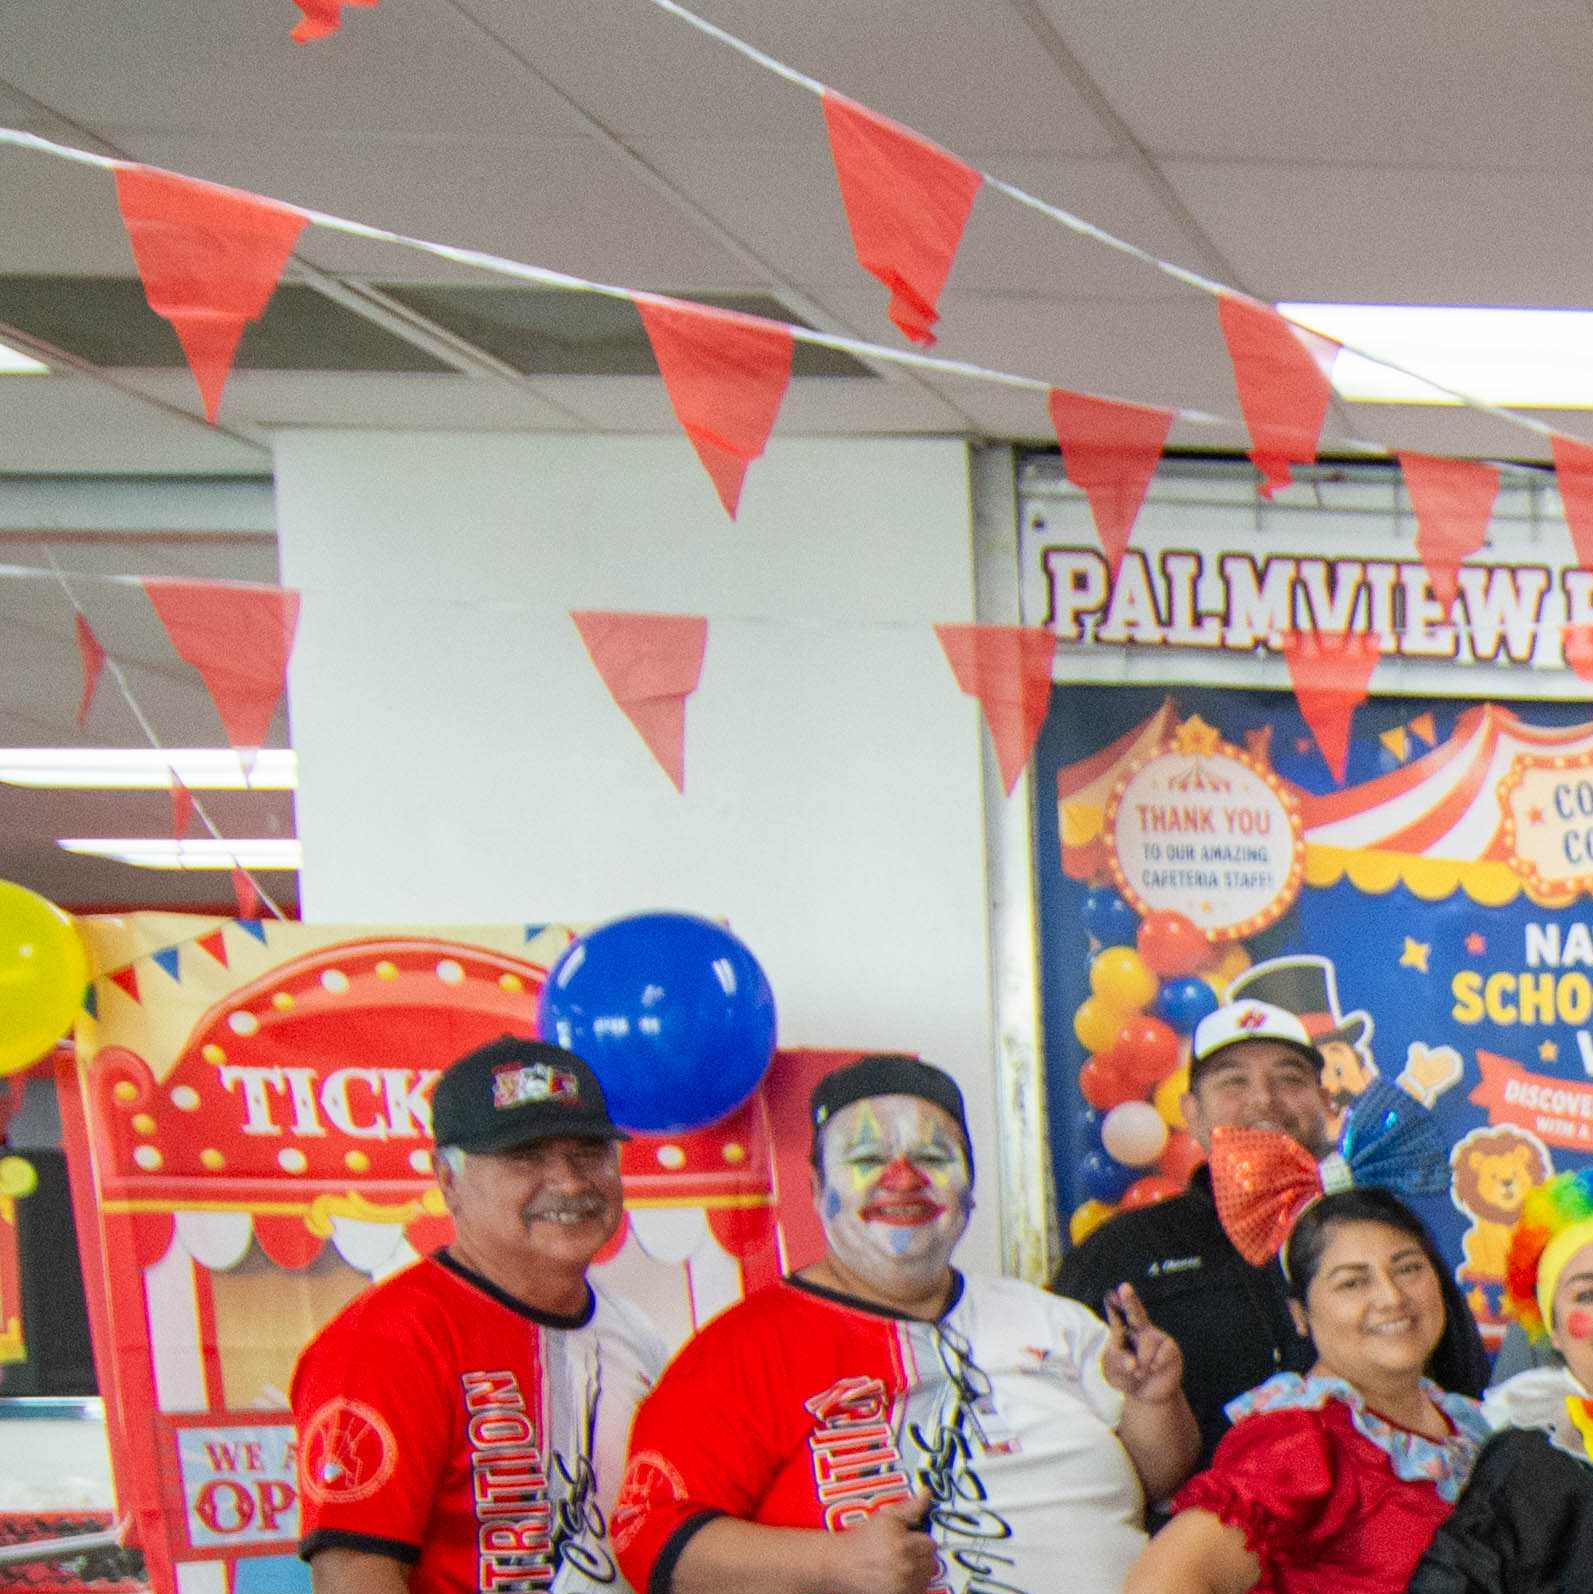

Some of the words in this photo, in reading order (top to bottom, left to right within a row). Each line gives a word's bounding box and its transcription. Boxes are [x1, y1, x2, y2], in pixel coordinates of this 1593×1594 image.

[1041, 546, 1552, 663] PALMVIEW
[1137, 804, 1216, 834] THANK
[1223, 807, 1271, 836] YOU
[1143, 843, 1162, 862] TO
[1167, 843, 1196, 862] OUR
[1200, 844, 1269, 863] AMAZING
[1142, 869, 1218, 888] CAFETERIA
[203, 1440, 265, 1472] WE
